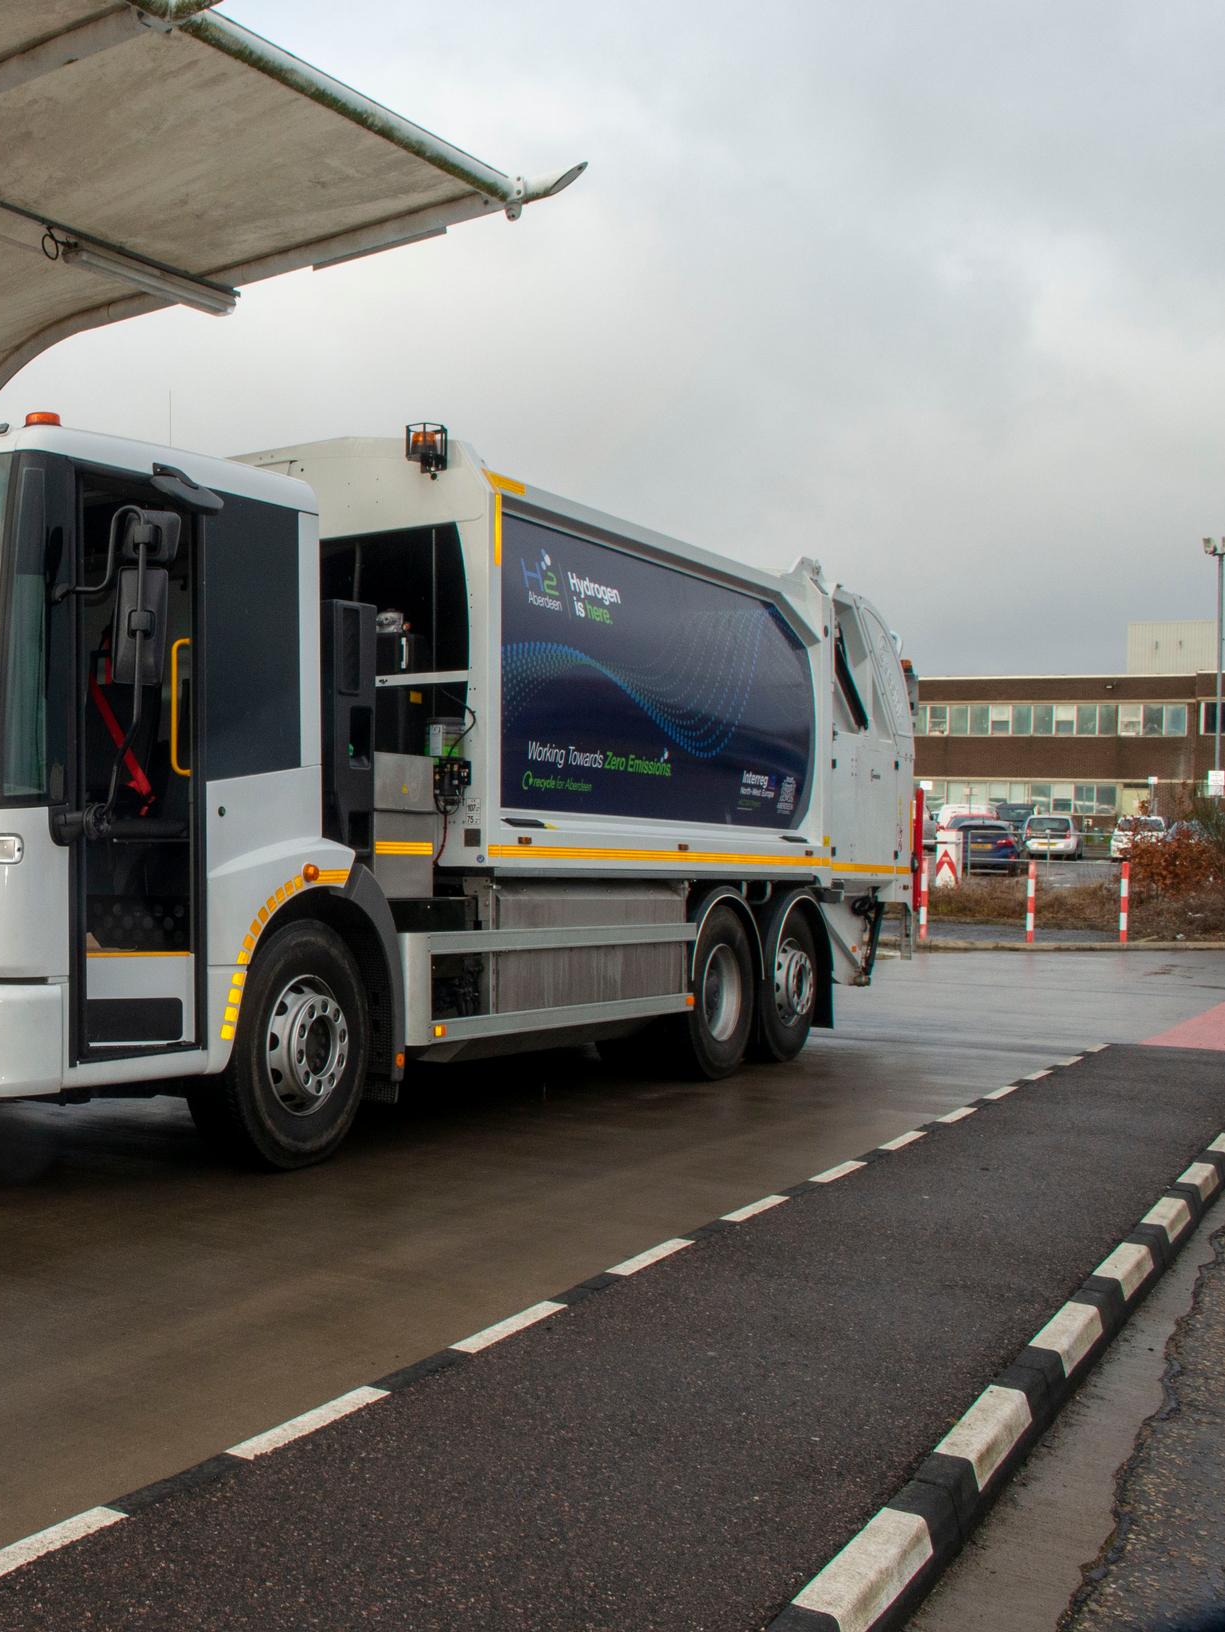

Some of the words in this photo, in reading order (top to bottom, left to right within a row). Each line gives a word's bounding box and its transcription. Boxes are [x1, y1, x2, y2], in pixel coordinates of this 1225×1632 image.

[567, 571, 621, 606] Hydrogen
[528, 591, 563, 611] Aberdeen
[573, 596, 585, 617] is
[585, 600, 613, 625] here.
[528, 740, 566, 768] Working
[568, 746, 604, 768] Towards
[604, 751, 626, 770] Zero
[627, 754, 672, 777] Emissions.
[533, 776, 555, 791] recycle
[555, 776, 565, 789] for
[565, 778, 592, 792] Aberdeen
[742, 770, 769, 788] Interreg
